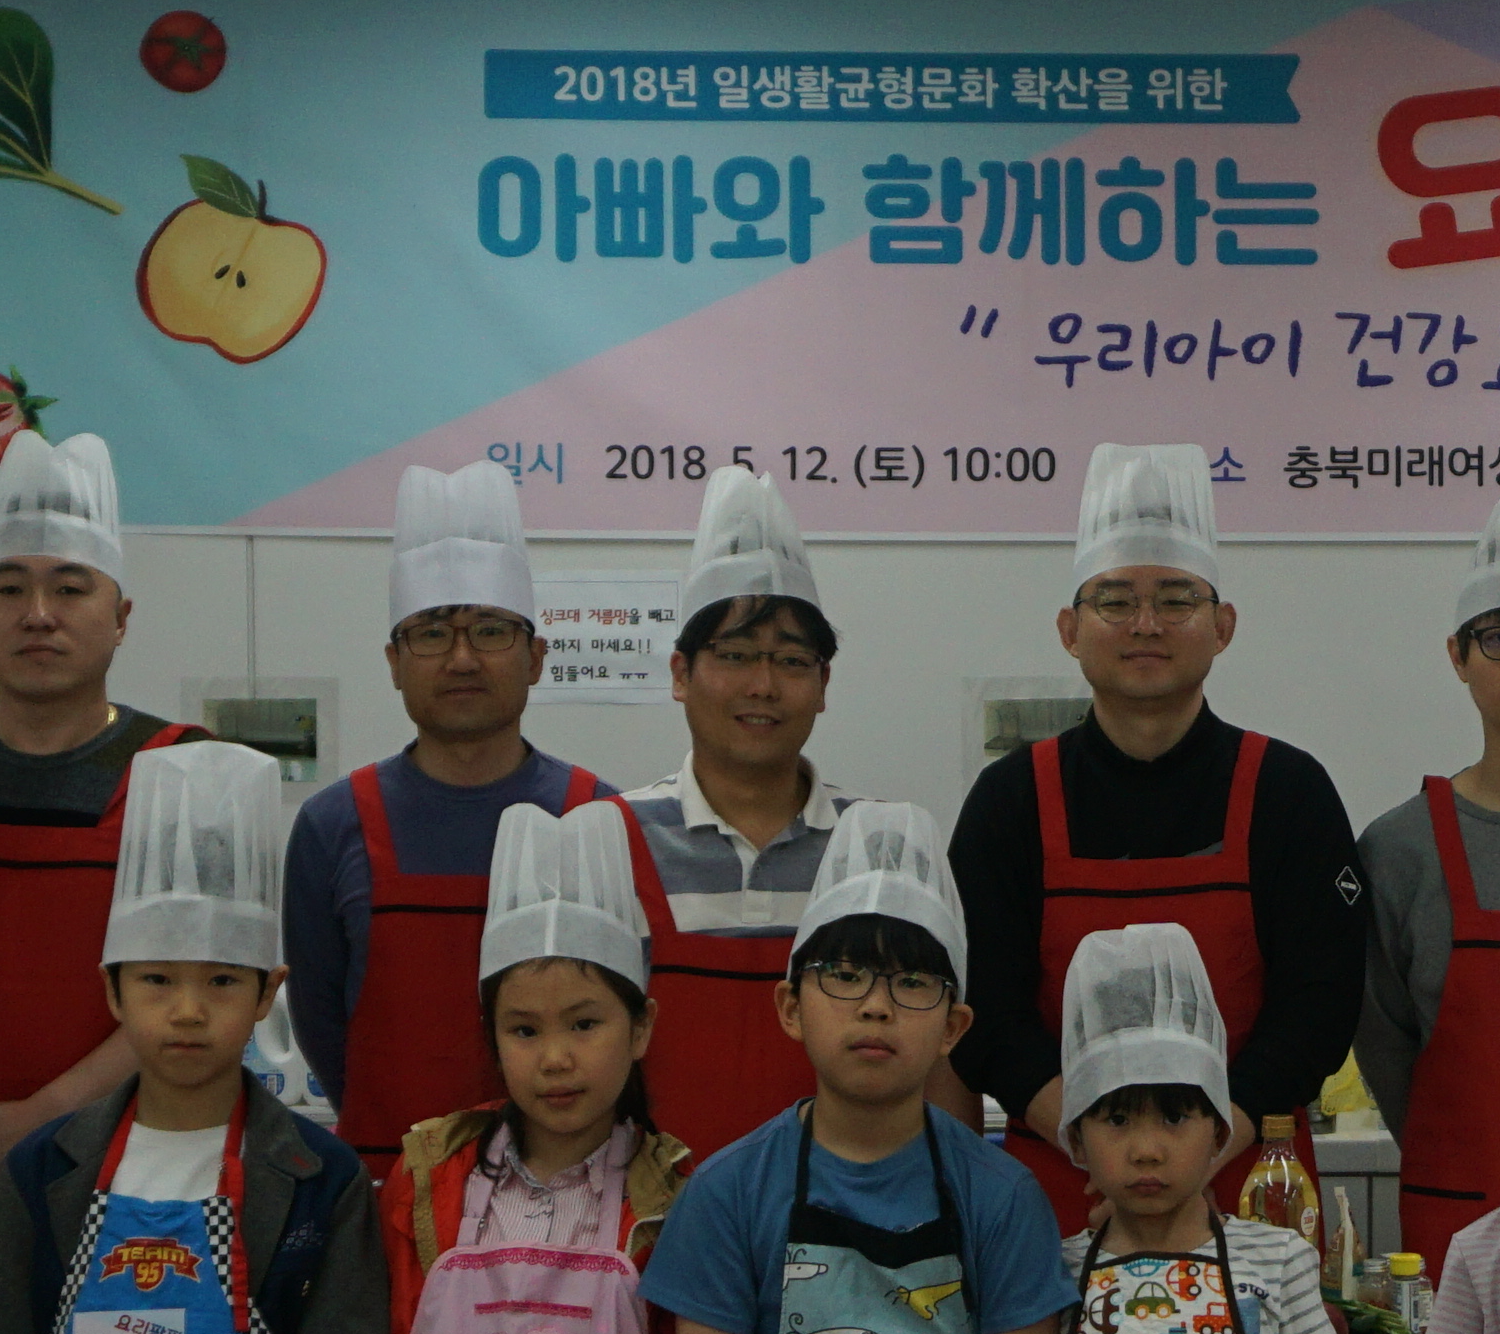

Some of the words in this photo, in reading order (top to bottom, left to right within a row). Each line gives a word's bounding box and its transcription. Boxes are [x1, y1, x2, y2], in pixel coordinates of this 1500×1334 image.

[553, 64, 698, 109] 2018년
[712, 65, 999, 111] 일생활균형문화
[1010, 66, 1133, 111] 확산을
[1147, 66, 1228, 111] 위한
[477, 153, 826, 265] 아빠와
[862, 153, 1320, 266] 함께하는
[781, 445, 839, 484] 12.
[853, 443, 926, 489] (토)
[942, 445, 1056, 483] 10:00
[1208, 446, 1247, 483] 소
[539, 608, 581, 626] 싱크대
[647, 609, 676, 624] 빼고
[591, 638, 651, 655] 마세요!!
[549, 665, 610, 683] 힘들어요
[117, 1245, 185, 1264] TEAM
[135, 1261, 161, 1284] 95
